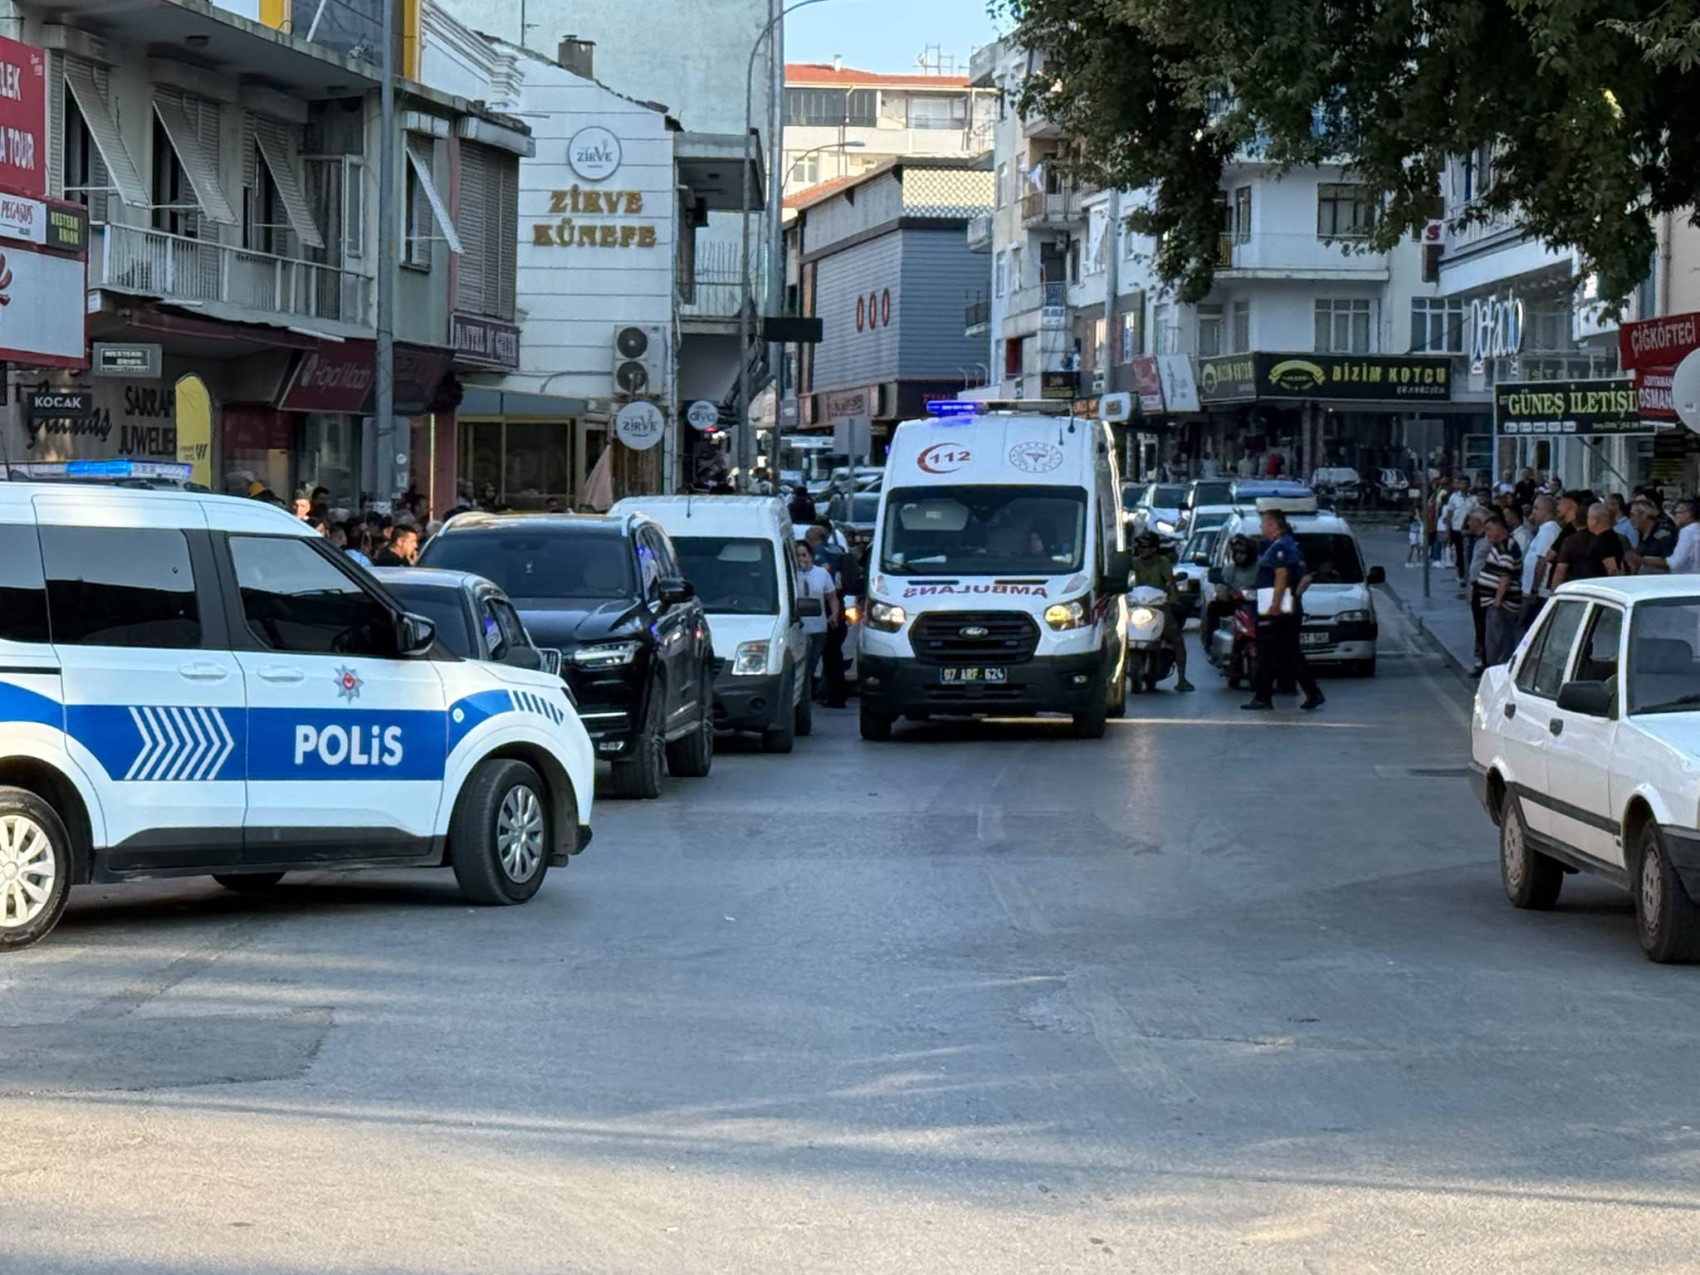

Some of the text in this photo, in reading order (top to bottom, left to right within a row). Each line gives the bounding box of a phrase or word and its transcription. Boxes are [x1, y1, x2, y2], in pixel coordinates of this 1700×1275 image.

[8, 127, 35, 171] TOUR
[549, 184, 643, 214] ZİRVE
[533, 218, 657, 248] KÜNEFE
[1333, 362, 1382, 383] BİZİM
[1509, 389, 1565, 420] GÜNEŞ
[930, 450, 971, 465] 112
